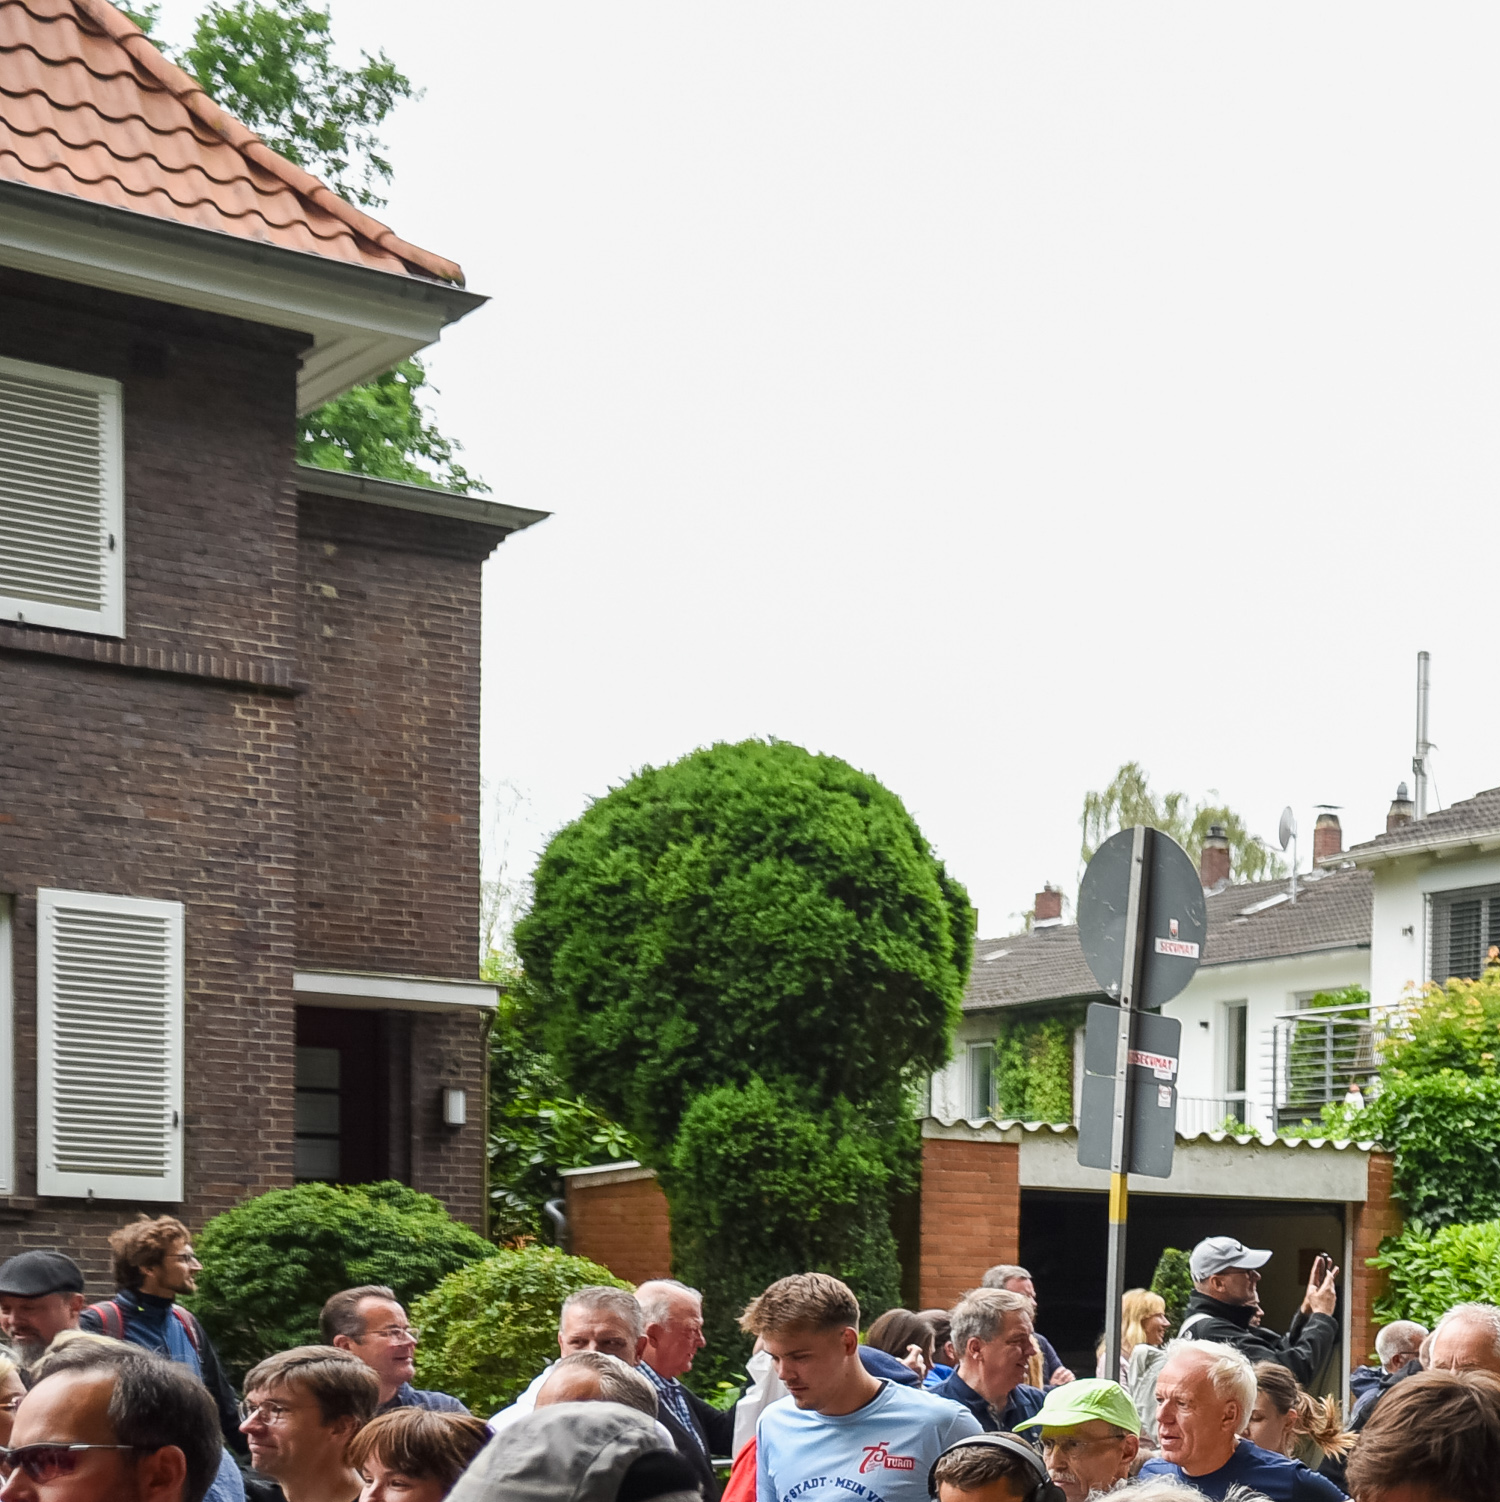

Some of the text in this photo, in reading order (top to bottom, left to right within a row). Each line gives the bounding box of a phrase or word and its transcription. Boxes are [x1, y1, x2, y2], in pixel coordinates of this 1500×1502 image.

[887, 1457, 914, 1470] TURM
[789, 1476, 827, 1499] STADT
[835, 1477, 867, 1496] MEIN
